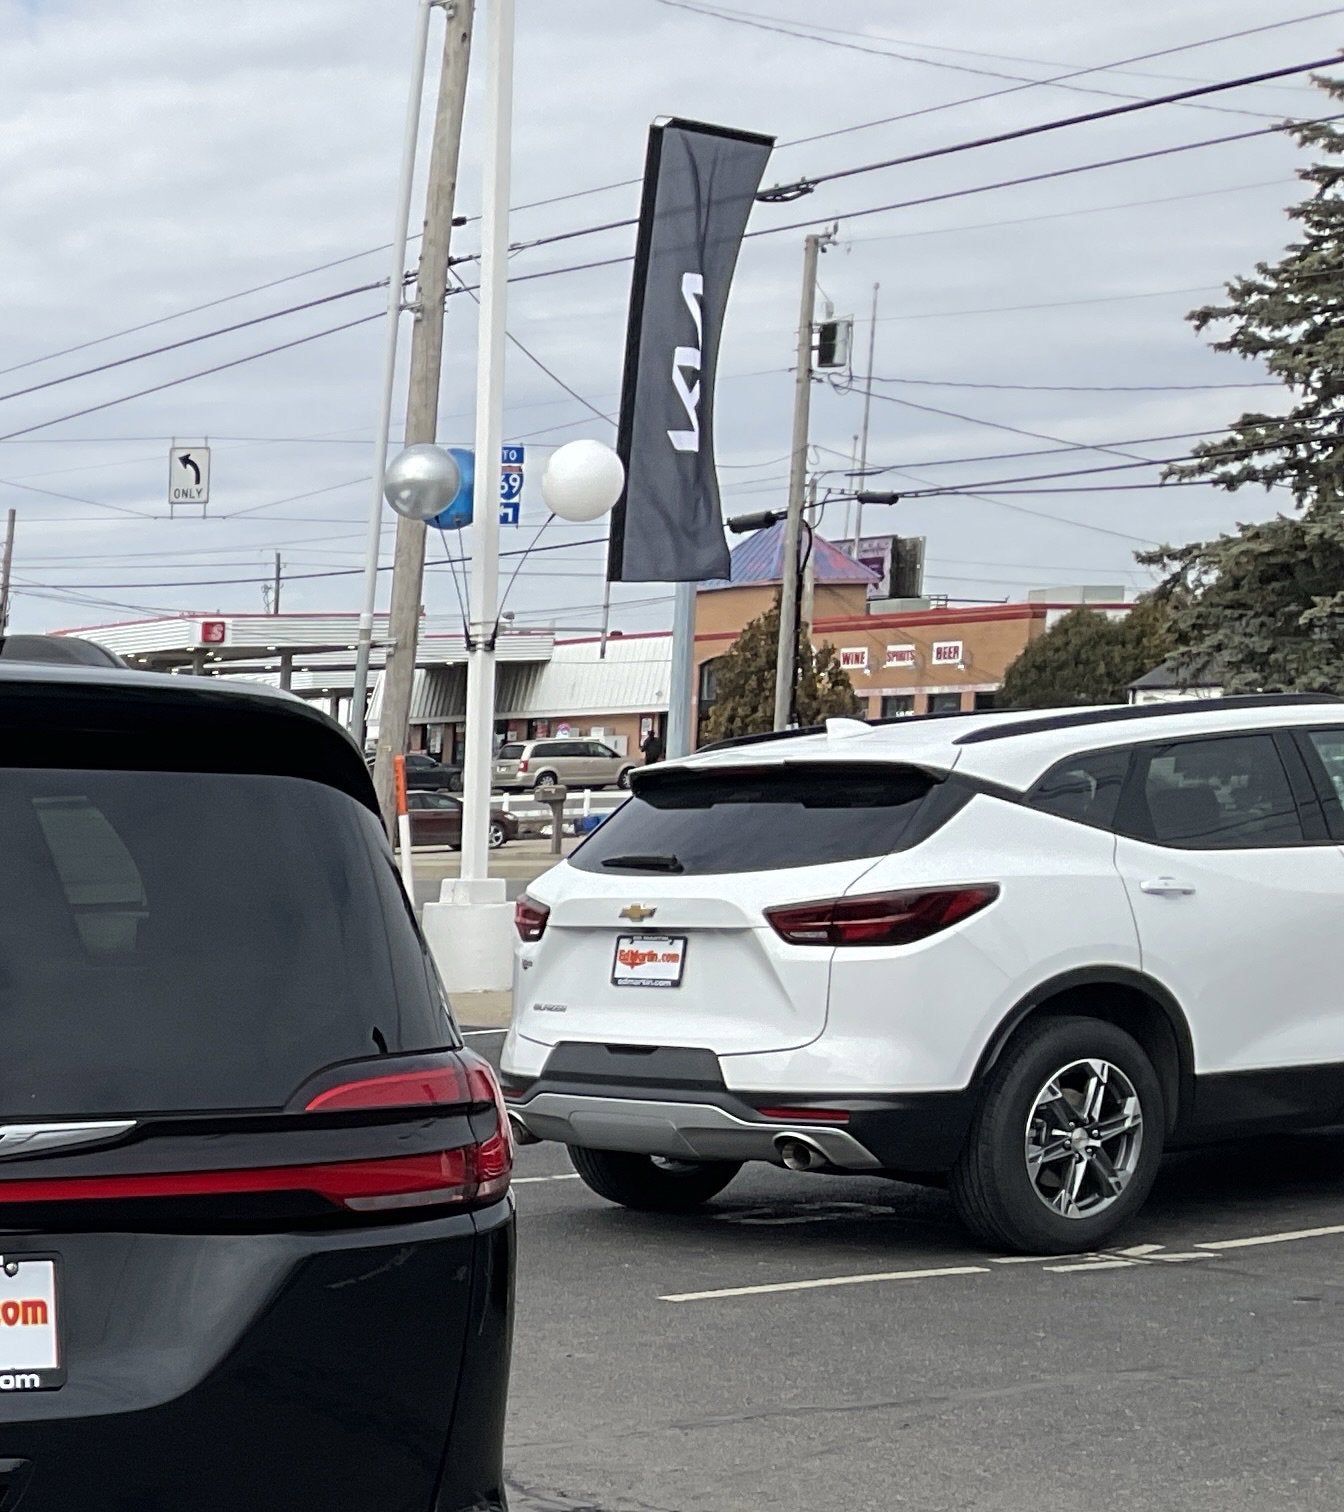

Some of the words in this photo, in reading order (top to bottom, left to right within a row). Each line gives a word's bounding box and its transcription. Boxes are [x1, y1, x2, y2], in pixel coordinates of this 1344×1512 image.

[503, 450, 517, 461] TO
[501, 474, 521, 494] 69
[173, 487, 203, 499] ONLY
[842, 651, 865, 665] WINE
[936, 645, 960, 660] BEER
